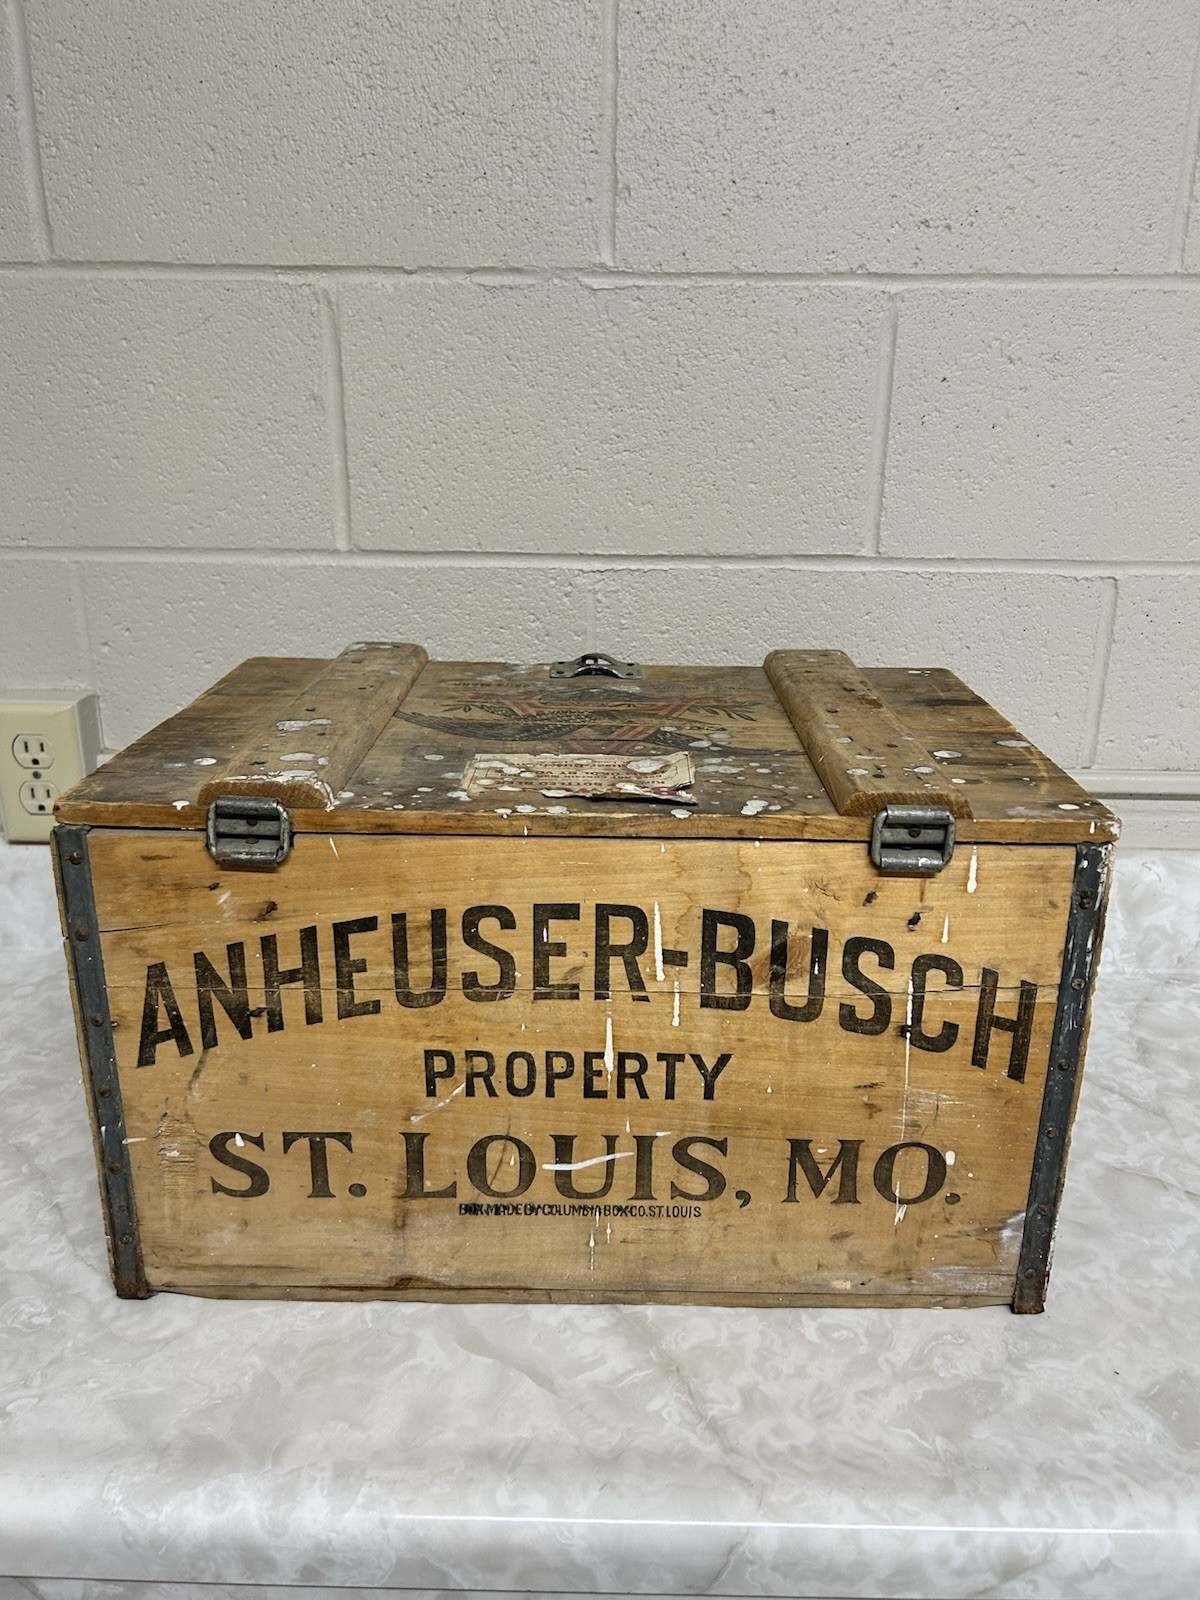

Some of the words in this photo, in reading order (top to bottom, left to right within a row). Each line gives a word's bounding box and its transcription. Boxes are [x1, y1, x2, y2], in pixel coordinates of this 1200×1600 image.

[137, 903, 1038, 1085] ANHEUSER-BUSCH
[424, 1049, 733, 1101] PROPERTY
[208, 1131, 368, 1199] ST.
[399, 1132, 752, 1208] LOUIS,
[785, 1138, 962, 1206] MO.
[666, 1205, 702, 1218] LOUIS
